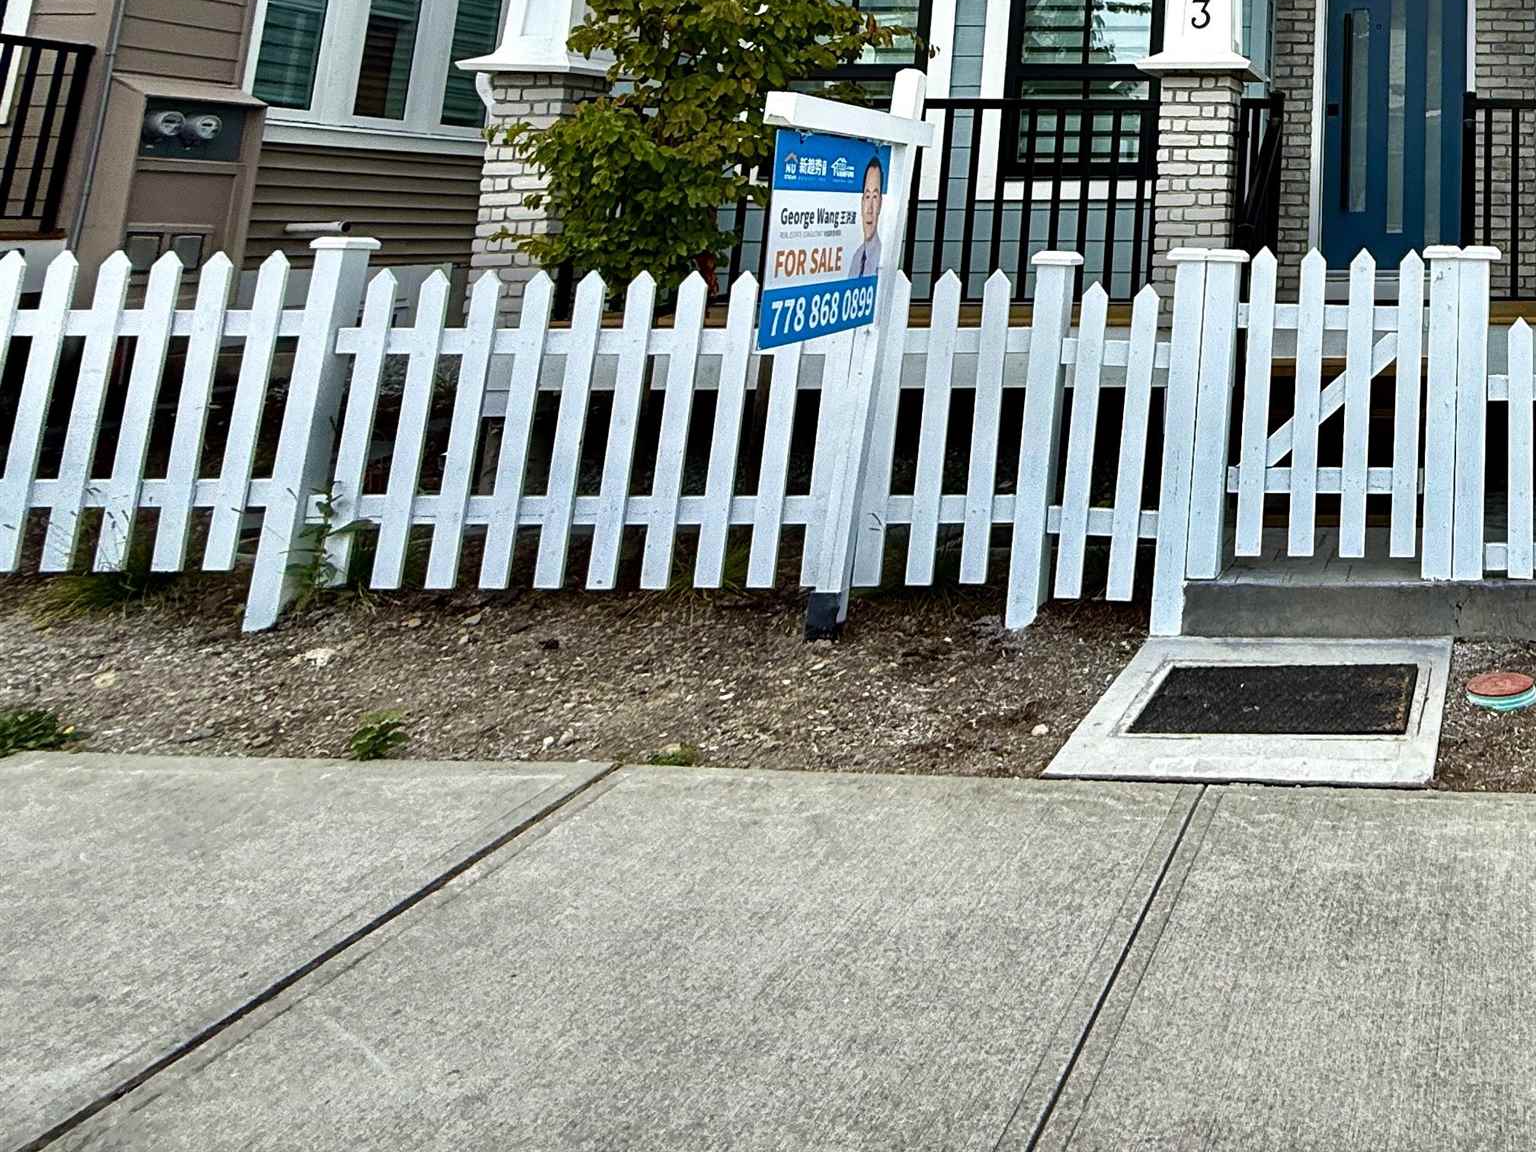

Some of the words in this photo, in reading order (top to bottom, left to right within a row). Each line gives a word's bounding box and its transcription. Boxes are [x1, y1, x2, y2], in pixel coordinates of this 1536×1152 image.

[780, 208, 815, 229] George
[817, 208, 840, 228] Wang
[774, 249, 807, 279] FOR
[809, 247, 843, 274] SALE
[770, 297, 806, 336] 778
[809, 291, 840, 328] 868
[842, 285, 874, 321] 0899
